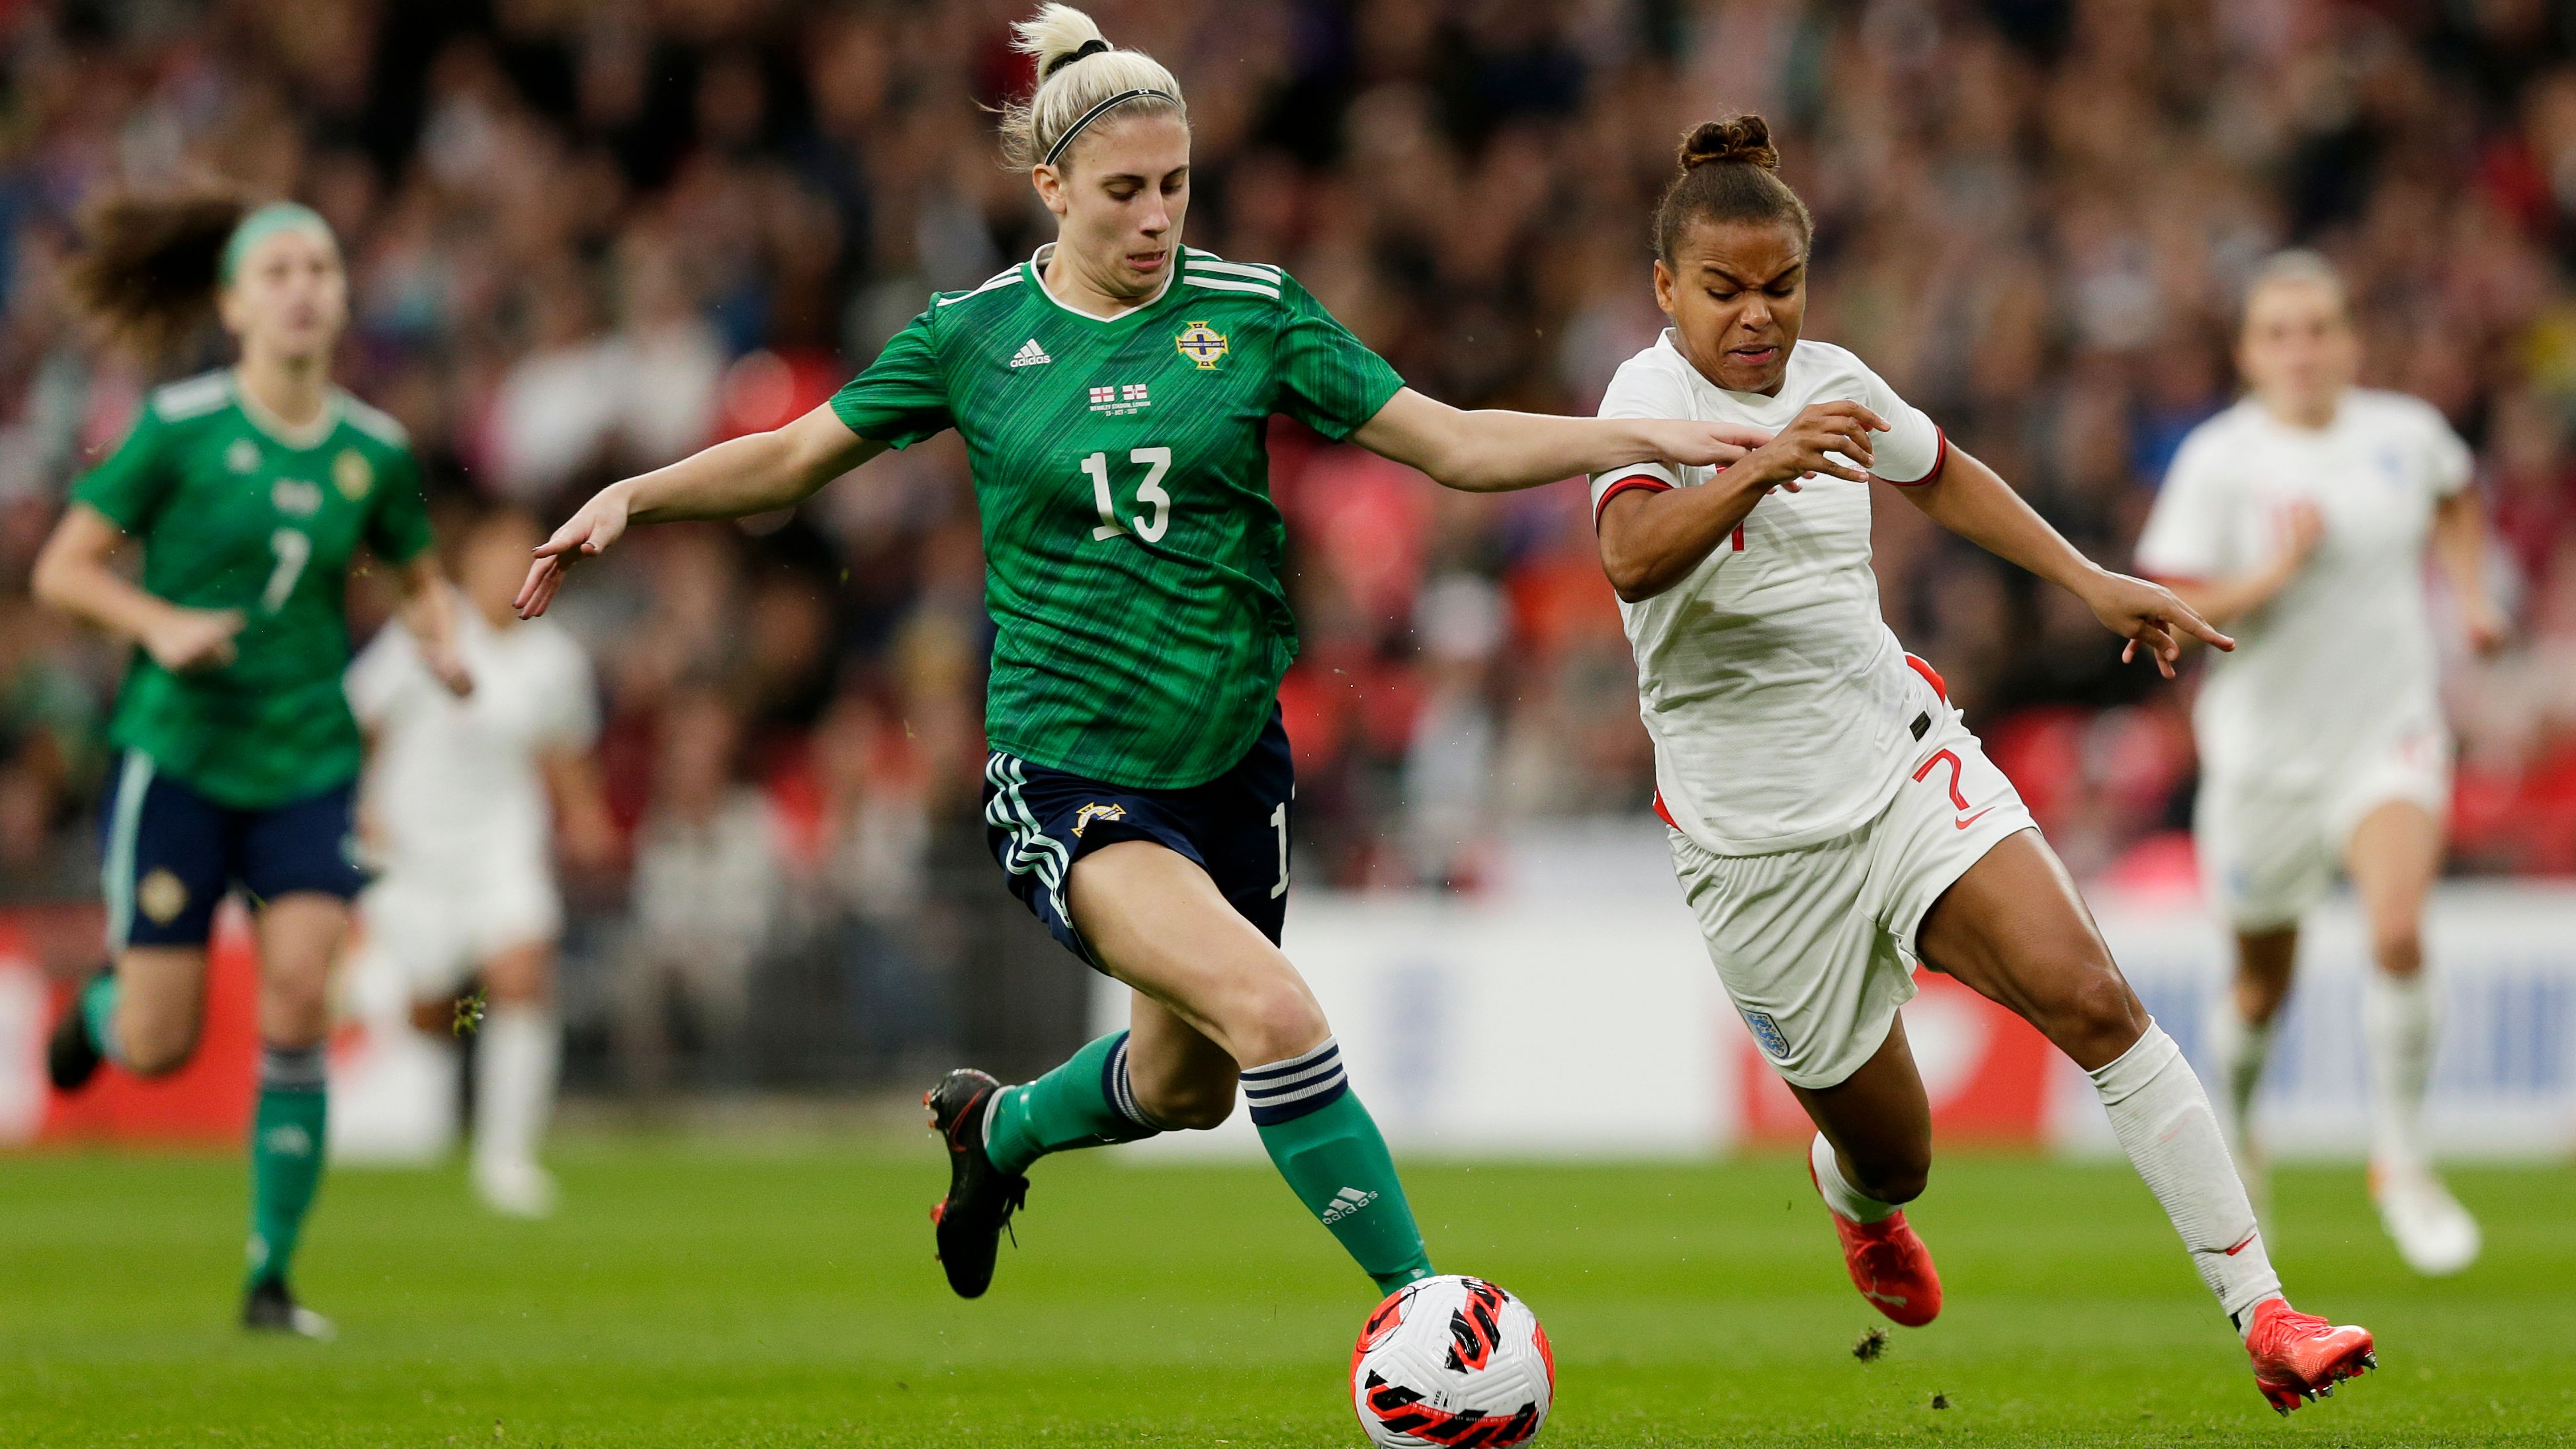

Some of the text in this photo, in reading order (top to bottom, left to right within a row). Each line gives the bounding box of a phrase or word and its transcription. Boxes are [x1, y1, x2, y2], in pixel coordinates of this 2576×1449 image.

[1010, 355, 1051, 367] adidas
[1080, 447, 1172, 543] 13
[261, 528, 312, 615] 7
[1912, 748, 1970, 811] 7
[1270, 781, 1295, 899] 1
[1322, 1190, 1378, 1225] adidas
[1433, 1389, 1442, 1405] FIFA
